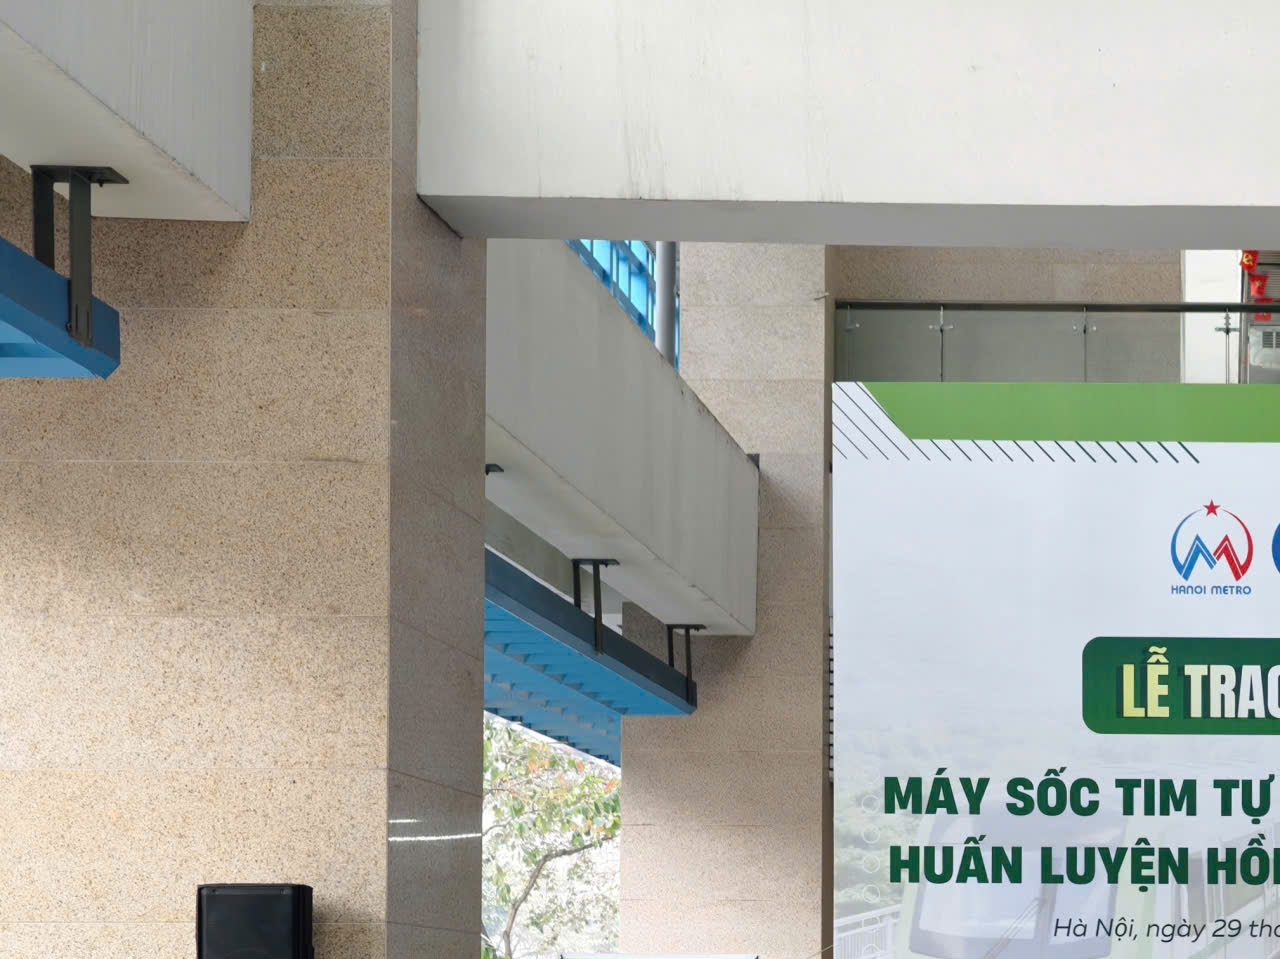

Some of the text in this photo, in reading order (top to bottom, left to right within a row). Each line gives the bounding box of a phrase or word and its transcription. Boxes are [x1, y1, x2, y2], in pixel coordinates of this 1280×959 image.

[1171, 585, 1252, 595] HANOI METRO
[1121, 645, 1170, 718] LỄ
[883, 767, 991, 815] MÁY
[1005, 766, 1100, 817] SỐC
[1115, 778, 1197, 817] TIM
[1213, 773, 1276, 825] TỰ
[889, 834, 1023, 884] HUẤN
[1040, 837, 1189, 893] LUYỆN
[1053, 917, 1088, 938] Hà
[1096, 916, 1139, 941] Nội,
[1145, 918, 1207, 943] ngày
[1211, 919, 1242, 938] 29
